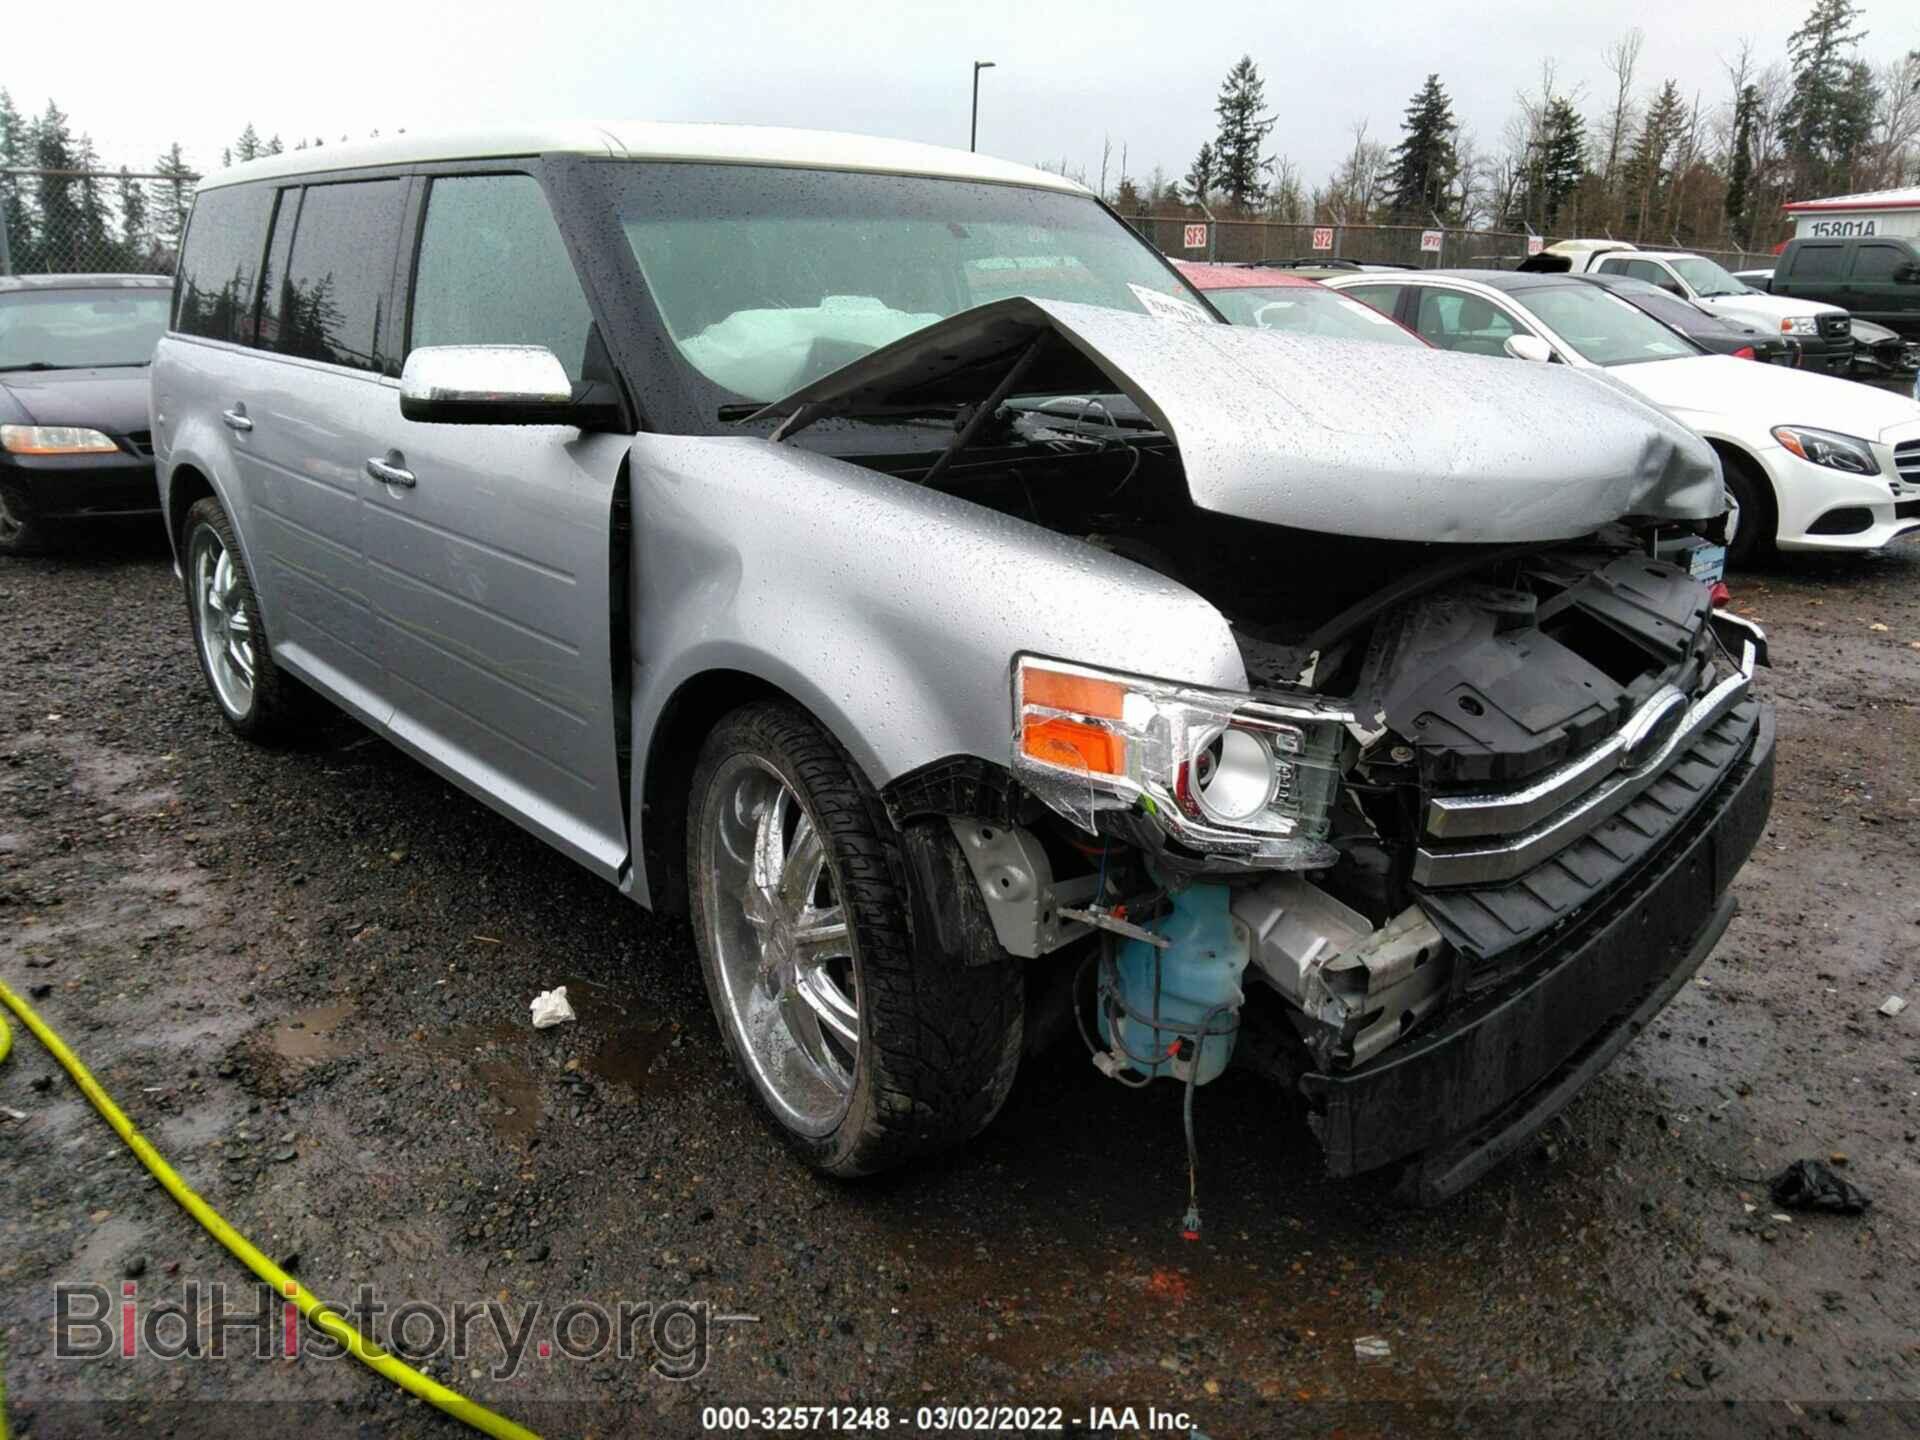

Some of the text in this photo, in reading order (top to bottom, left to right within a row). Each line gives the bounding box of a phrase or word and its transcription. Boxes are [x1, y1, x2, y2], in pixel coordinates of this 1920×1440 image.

[1186, 226, 1205, 245] SF3
[1811, 220, 1876, 237] 15801A
[1315, 230, 1331, 247] SF2
